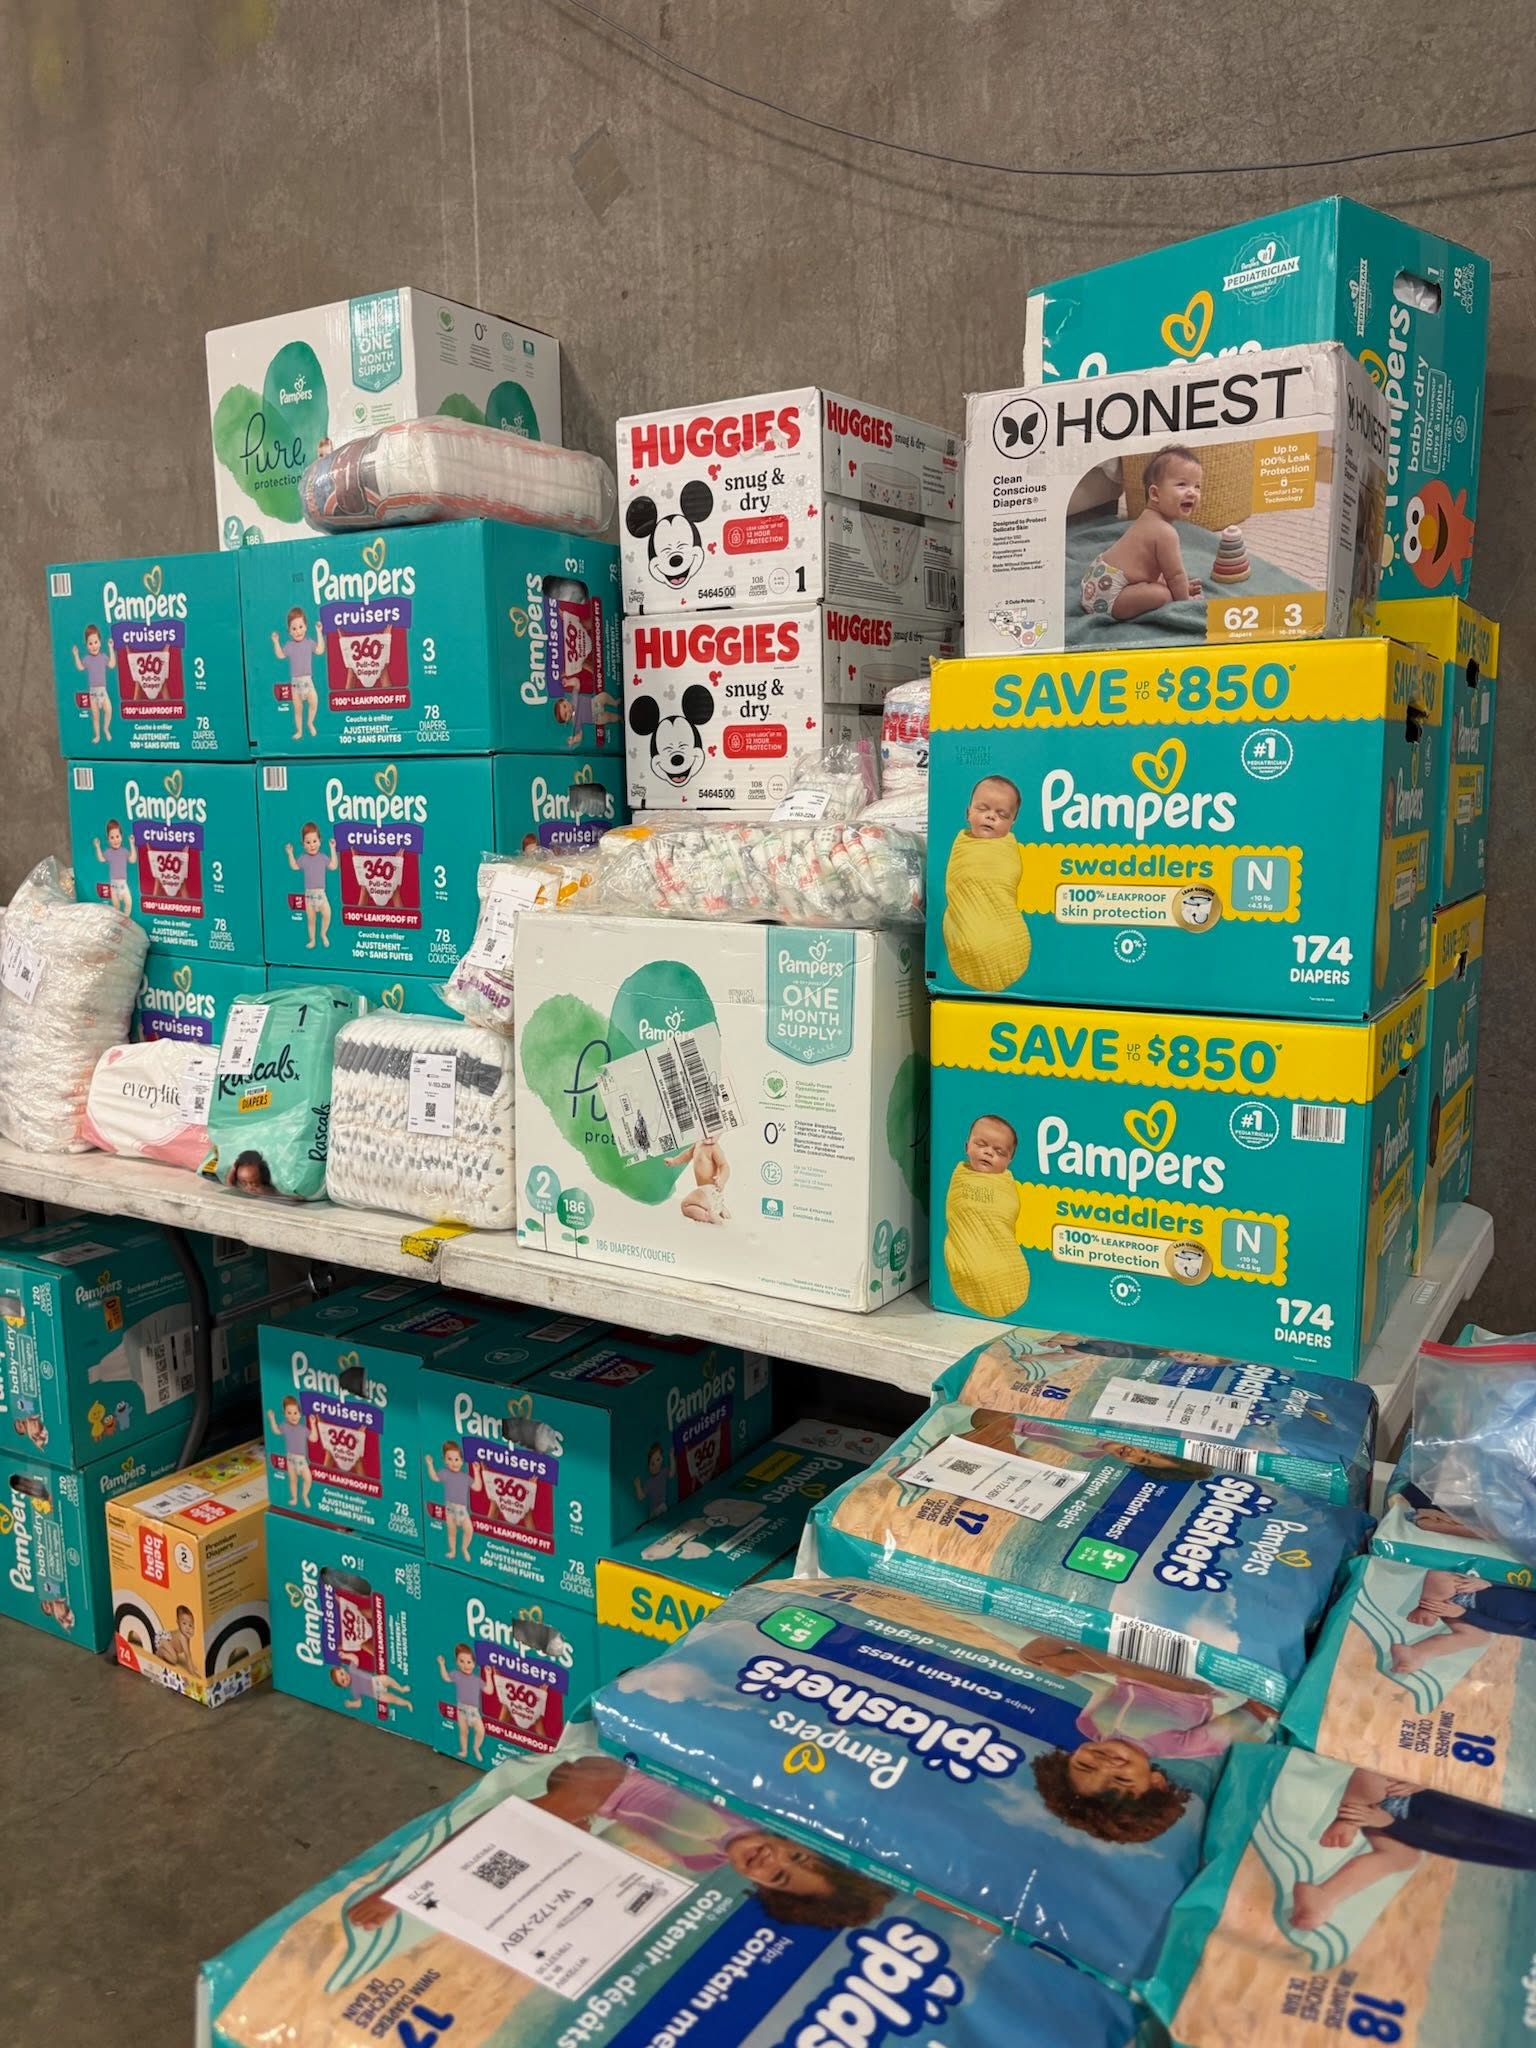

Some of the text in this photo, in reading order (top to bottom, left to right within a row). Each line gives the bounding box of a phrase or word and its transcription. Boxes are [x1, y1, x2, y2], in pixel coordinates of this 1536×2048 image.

[1227, 261, 1297, 289] PEDIATRICIAN
[1453, 266, 1463, 299] 198
[360, 333, 393, 351] ONE
[360, 350, 394, 367] MONTH
[280, 389, 313, 405] Pampers
[1056, 367, 1303, 447] HONEST
[827, 400, 893, 448] HUGGIES
[1353, 401, 1388, 455] HONEST
[631, 406, 801, 470] HUGGIES
[1260, 452, 1311, 466] 100% Leak
[1273, 444, 1298, 456] Up to
[725, 467, 785, 492] snug &
[993, 474, 1023, 486] Clean
[1260, 464, 1310, 477] Protection
[993, 483, 1047, 498] Conscious
[1264, 487, 1304, 498] Comfort Dry
[1265, 493, 1304, 504] Technology
[739, 493, 770, 513] dry
[229, 523, 239, 540] 2
[993, 518, 1017, 528] Designed
[1025, 516, 1047, 525] Protect
[565, 558, 578, 573] 3
[312, 558, 416, 606] Pampers
[751, 575, 764, 584] 108
[795, 566, 806, 593] 1
[103, 581, 187, 626] Pampers
[1283, 603, 1303, 627] 3
[334, 608, 400, 626] cruisers
[827, 610, 892, 646] HUGGIES
[1223, 607, 1259, 630] 62
[123, 629, 176, 643] cruisers
[520, 572, 548, 706] Pampers
[548, 598, 560, 681] cruisers
[635, 621, 801, 669] HUGGIES
[423, 638, 435, 662] 3
[194, 657, 205, 679] 3
[351, 694, 406, 705] LEAKPROOF FIT
[725, 677, 784, 700] snug &
[992, 667, 1128, 717] SAVE
[1135, 680, 1149, 690] UP
[1135, 690, 1150, 701] TO
[197, 717, 209, 729] 78
[423, 705, 440, 720] 78
[740, 702, 770, 721] dry
[344, 725, 389, 734] AJUSTEMENT
[416, 730, 450, 742] COUCHES
[419, 719, 447, 731] DIAPERS
[1253, 737, 1276, 760] #1
[751, 781, 762, 789] 108
[125, 780, 207, 826] Pampers
[325, 778, 428, 828] Pampers
[1041, 768, 1237, 841] Pampers
[1396, 767, 1424, 831] Pampers
[144, 827, 195, 843] cruisers
[347, 831, 412, 846] cruisers
[212, 861, 223, 882] 3
[434, 865, 447, 889] 3
[1059, 854, 1214, 879] swaddlers
[1247, 860, 1275, 892] N
[1068, 888, 1167, 903] 100% LEAKPROOF
[363, 913, 418, 924] LEAKPROOF FIT
[1062, 905, 1167, 920] skin protection
[214, 919, 226, 931] 78
[434, 929, 450, 943] 78
[356, 942, 401, 951] AJUSTEMENT
[430, 942, 457, 955] DIAPERS
[1291, 935, 1353, 967] 174
[428, 953, 460, 965] COUCHES
[778, 950, 843, 978] Pampers
[1289, 968, 1350, 985] DIAPERS
[782, 985, 839, 1010] ONE
[299, 1004, 307, 1027] 1
[781, 1008, 840, 1026] MONTH
[152, 1020, 203, 1038] cruisers
[988, 1021, 1120, 1071] SAVE
[1127, 1042, 1141, 1053] UP
[1126, 1052, 1141, 1062] TO
[242, 1094, 268, 1110] DIAPERS
[308, 1102, 331, 1162] Rascals
[1241, 1110, 1263, 1132] #1
[1037, 1115, 1226, 1195] Pampers
[536, 1171, 551, 1199] 2
[563, 1199, 585, 1214] 186
[1056, 1199, 1204, 1236] swaddlers
[1101, 1237, 1160, 1253] LEAKPROOF
[1236, 1224, 1262, 1255] N
[596, 1239, 676, 1264] 186 DIAPERS/COUCHES
[1059, 1244, 1160, 1269] skin protection
[32, 1286, 40, 1305] 120
[1275, 1297, 1334, 1332] 174
[1274, 1328, 1332, 1349] DIAPERS
[666, 1364, 736, 1432] Pampers
[312, 1400, 374, 1425] cruisers
[682, 1405, 727, 1443] cruisers
[393, 1448, 406, 1468] 3
[477, 1447, 546, 1475] cruisers
[59, 1476, 67, 1495] 120
[394, 1502, 409, 1516] 78
[569, 1501, 583, 1523] 3
[954, 1508, 990, 1536] 17
[1106, 1514, 1132, 1540] mess
[1161, 1476, 1254, 1587] splashers
[37, 1510, 47, 1577] baby-dry
[493, 1526, 551, 1549] LEAKPROOF FIT
[1241, 1518, 1308, 1576] Pampers
[181, 1552, 187, 1563] 2
[341, 1554, 357, 1569] 3
[568, 1560, 585, 1576] 78
[1100, 1548, 1126, 1571] 5+
[395, 1567, 406, 1585] 78
[563, 1571, 592, 1587] DIAPERS
[560, 1579, 594, 1597] COUCHES
[296, 1558, 324, 1666] Pampers
[324, 1583, 336, 1651] cruisers
[778, 1623, 812, 1642] 5+
[119, 1647, 131, 1662] 74
[489, 1651, 557, 1685] cruisers
[857, 1644, 1003, 1700] contain mess
[744, 1661, 1019, 1776] splashers
[1440, 1710, 1455, 1731] SWIM
[769, 1710, 910, 1789] Pampers
[1451, 1731, 1496, 1767] 18
[500, 1887, 576, 1952] W-172-XBV
[650, 1889, 723, 1967] contenir
[695, 1927, 776, 2011] contain
[412, 1967, 441, 1997] SWIM
[1346, 1991, 1407, 2044] 18
